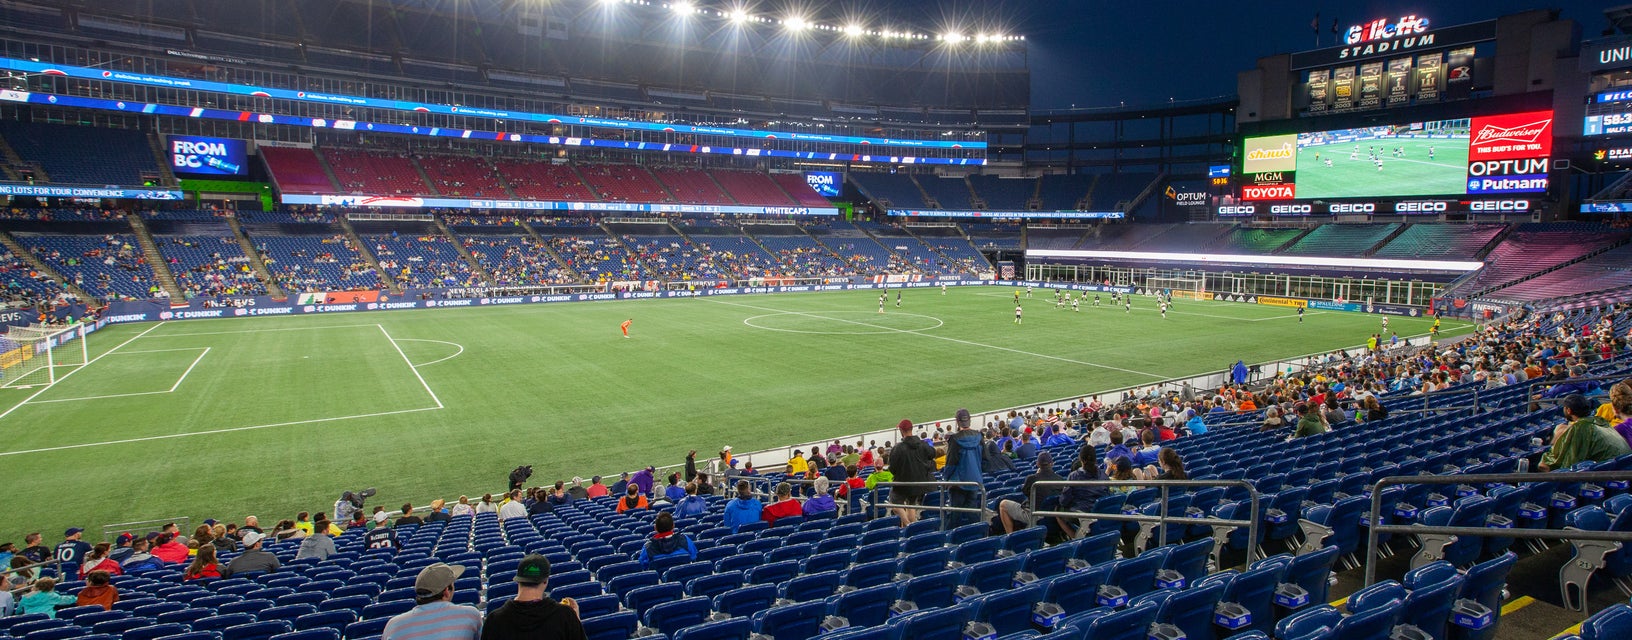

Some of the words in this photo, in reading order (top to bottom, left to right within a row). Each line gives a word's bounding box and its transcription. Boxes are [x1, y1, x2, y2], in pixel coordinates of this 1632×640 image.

[1343, 14, 1429, 44] Gillette
[1339, 34, 1435, 58] STADIUM
[1600, 46, 1632, 64] UNI
[1478, 128, 1542, 140] Budweiser
[172, 140, 228, 156] FROM
[1492, 145, 1511, 153] BUD'S
[174, 154, 203, 168] BC
[1469, 158, 1549, 176] OPTUM
[807, 175, 833, 184] FROM
[1254, 172, 1283, 181] MGM
[1482, 178, 1547, 190] Putnam
[13, 186, 33, 194] LOTS
[34, 187, 50, 195] FOR
[51, 188, 72, 196] YOUR
[73, 189, 124, 197] CONVENIENCE
[1244, 187, 1293, 198] TOYOTA
[1176, 192, 1207, 201] OPTUM
[1271, 204, 1312, 213] GEICO
[1329, 203, 1375, 212] GEICO
[1395, 202, 1447, 211] GEICO
[1470, 200, 1529, 210] GEICO
[1218, 206, 1255, 214] GEICO
[444, 299, 472, 307] DUNKIN'
[497, 297, 524, 305] DUNKIN'
[1259, 296, 1289, 305] Continental
[325, 304, 357, 312] DUNKIN'
[386, 302, 417, 310] DUNKIN'
[184, 310, 223, 319] DUNKIN'
[257, 307, 293, 316] DUNKIN'
[0, 312, 20, 322] EVS
[110, 313, 147, 323] DUNKIN'
[57, 547, 75, 561] 10
[1579, 560, 1589, 568] 21
